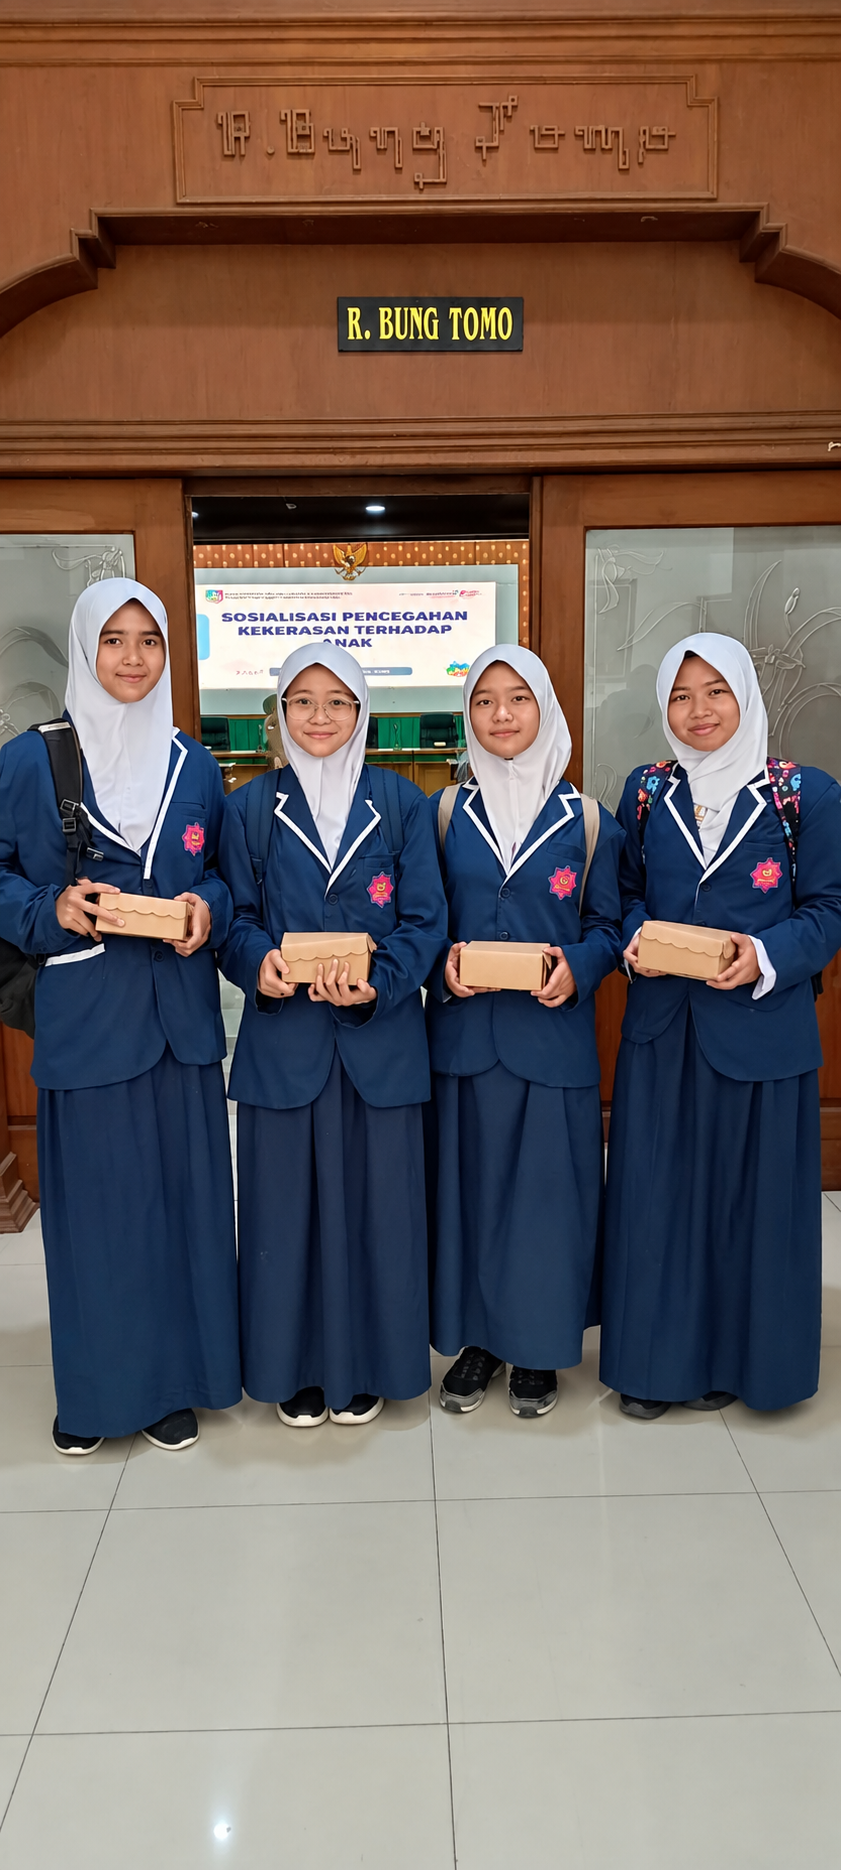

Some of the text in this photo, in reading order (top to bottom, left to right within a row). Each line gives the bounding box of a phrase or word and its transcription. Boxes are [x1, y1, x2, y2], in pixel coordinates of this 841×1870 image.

[280, 109, 448, 190] Bung
[347, 307, 513, 341] R. BUNG TOMO
[221, 611, 468, 622] SOSIALISASI PENCEGAHAN
[238, 624, 452, 636] KEKERASAN TERHADAP
